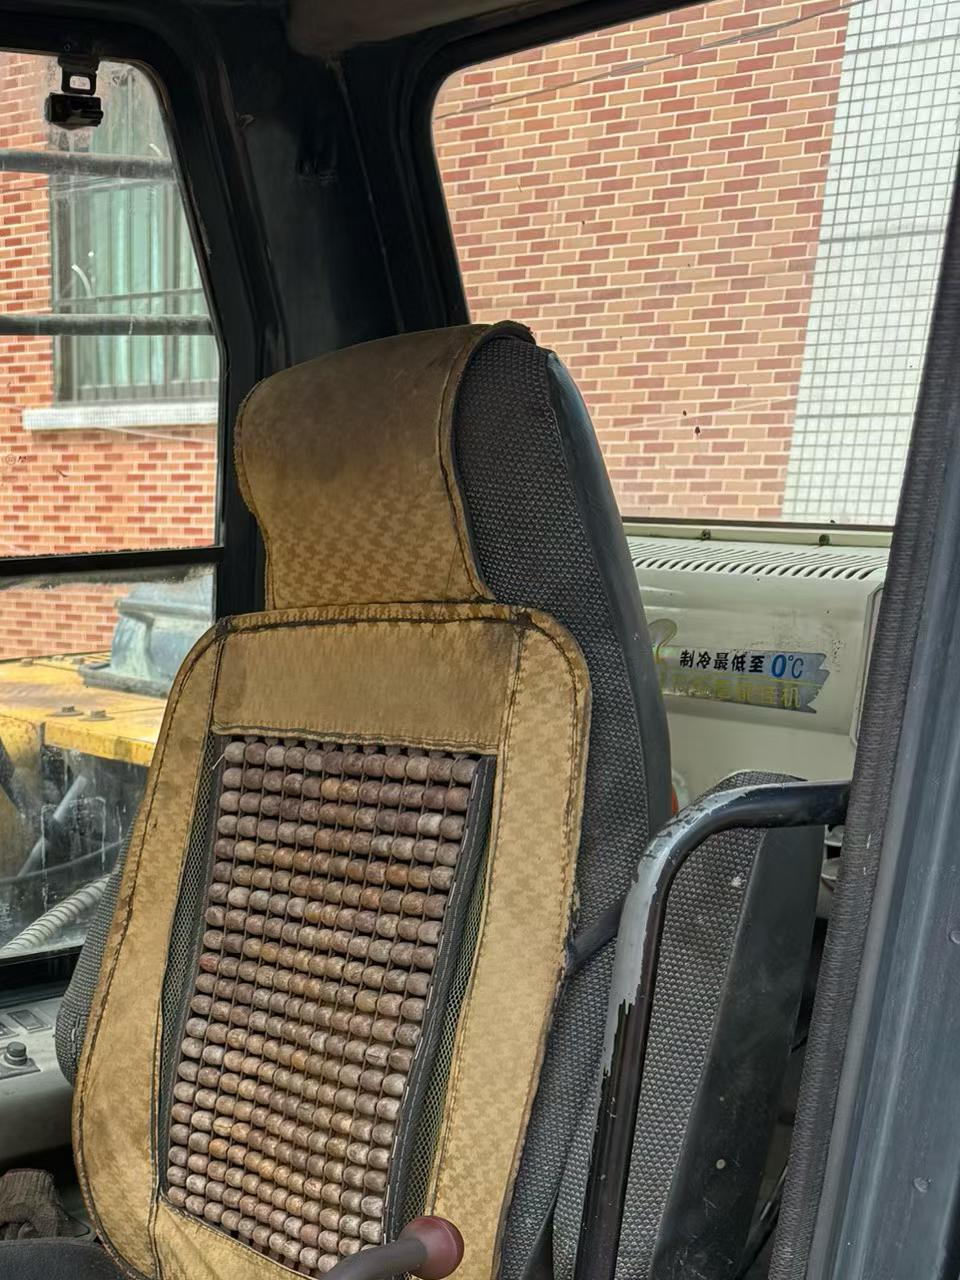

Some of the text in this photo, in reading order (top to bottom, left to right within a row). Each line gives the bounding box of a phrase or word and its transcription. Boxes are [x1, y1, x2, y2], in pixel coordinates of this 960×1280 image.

[680, 650, 765, 673] 制冷最低至
